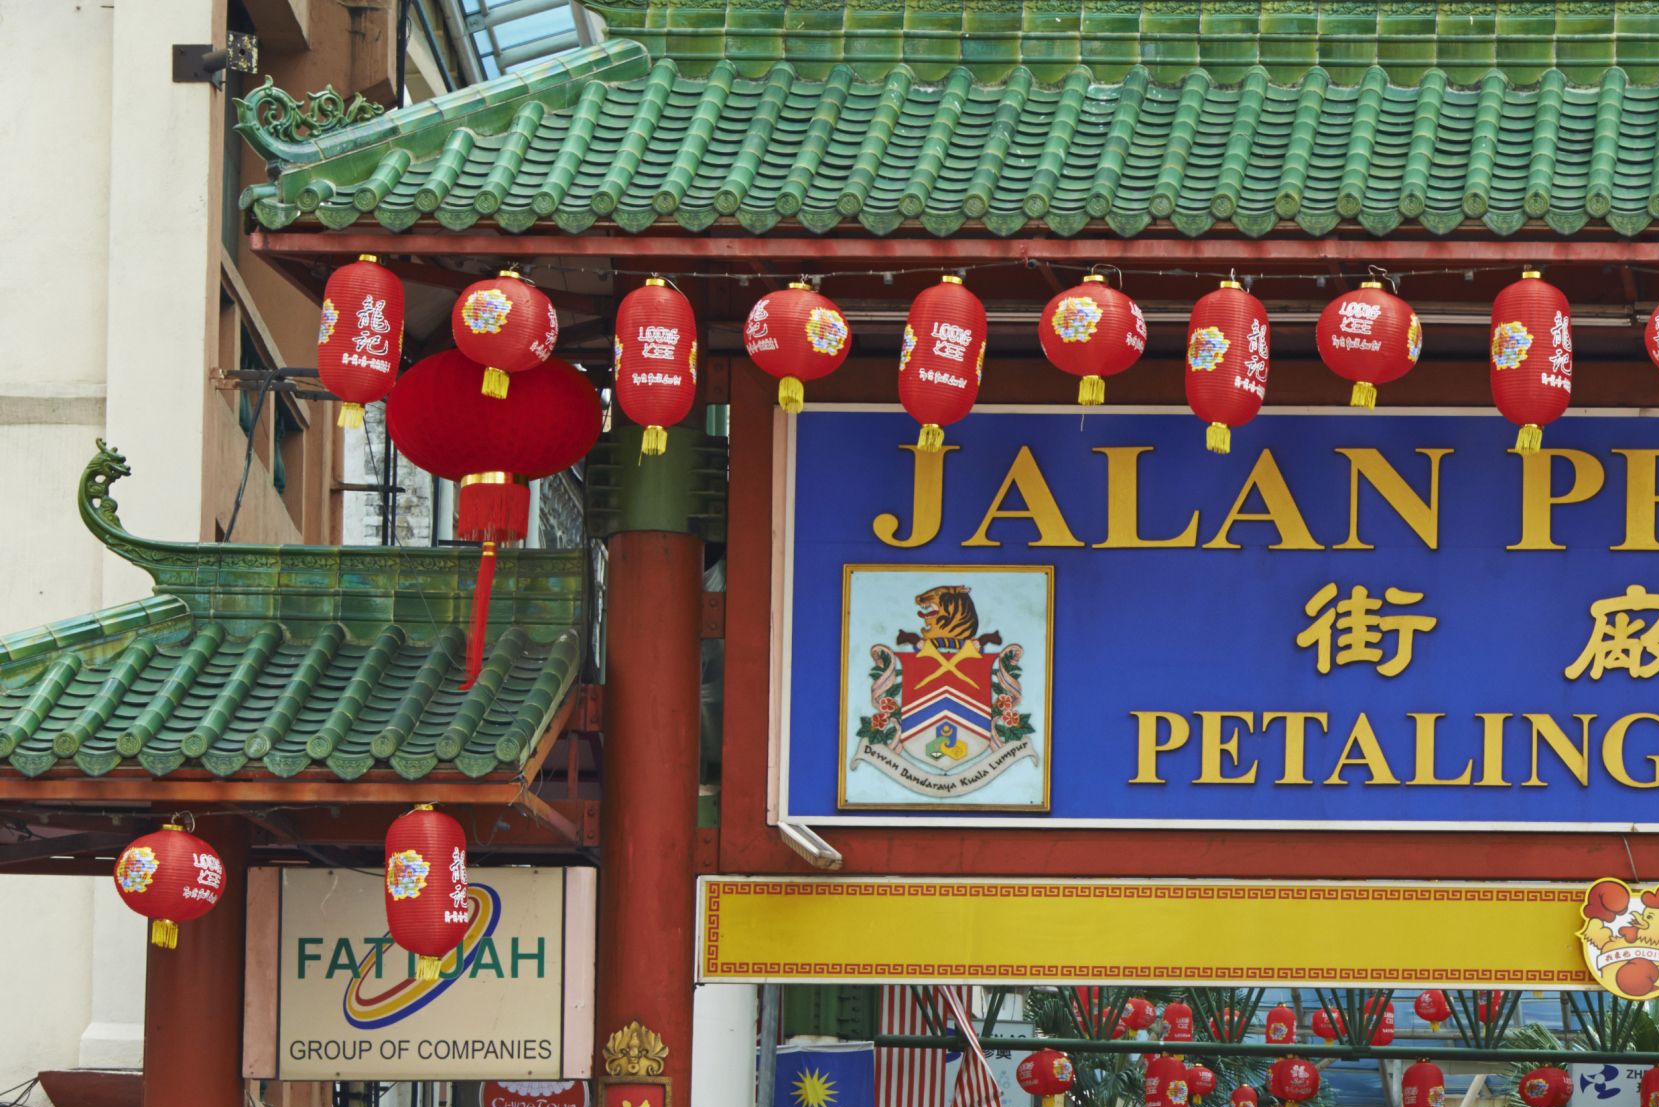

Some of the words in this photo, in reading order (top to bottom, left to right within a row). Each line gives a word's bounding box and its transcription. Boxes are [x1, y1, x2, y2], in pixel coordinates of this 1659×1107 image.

[873, 444, 1455, 551] JALAN
[864, 745, 900, 770] Dewan
[900, 770, 957, 792] Bandaraya
[960, 770, 989, 786] Kuala
[990, 741, 1028, 770] Lumpur
[290, 1040, 372, 1060] GROUP
[380, 1040, 410, 1060] OF
[418, 1040, 552, 1060] COMPANIES
